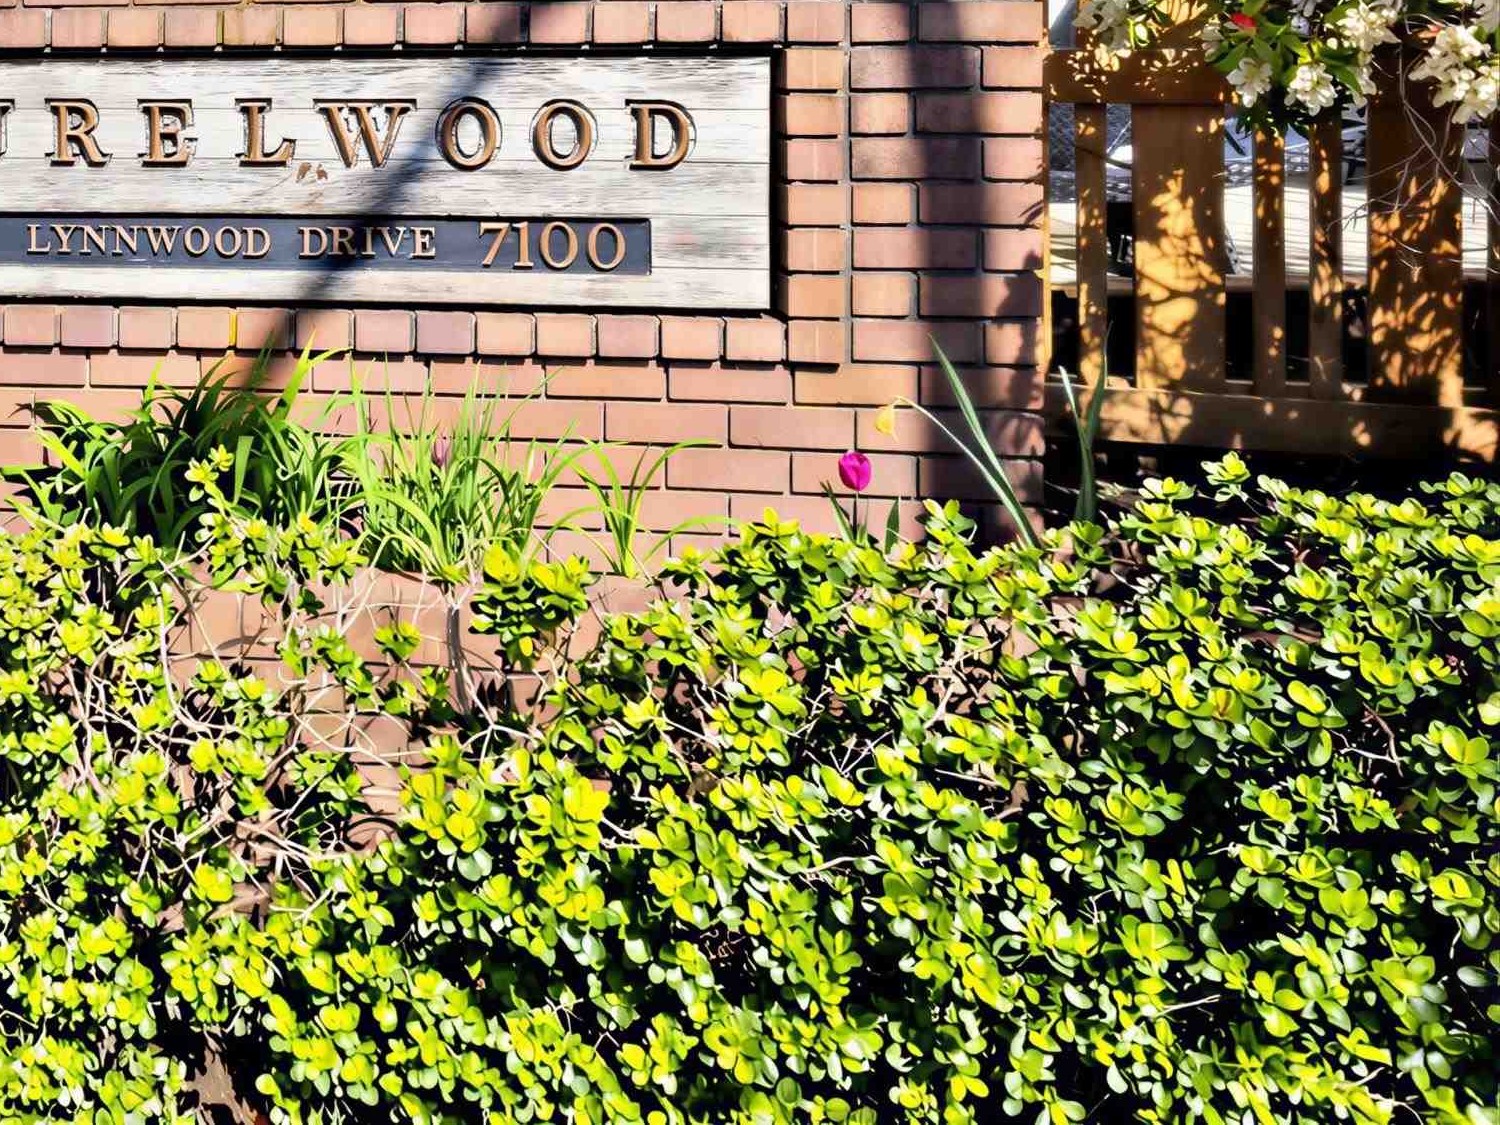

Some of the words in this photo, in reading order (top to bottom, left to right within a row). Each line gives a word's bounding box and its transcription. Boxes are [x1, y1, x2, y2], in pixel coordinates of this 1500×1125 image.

[26, 223, 271, 259] LYNNWOOD
[299, 226, 436, 259] DRIVE
[479, 221, 627, 270] 7100
